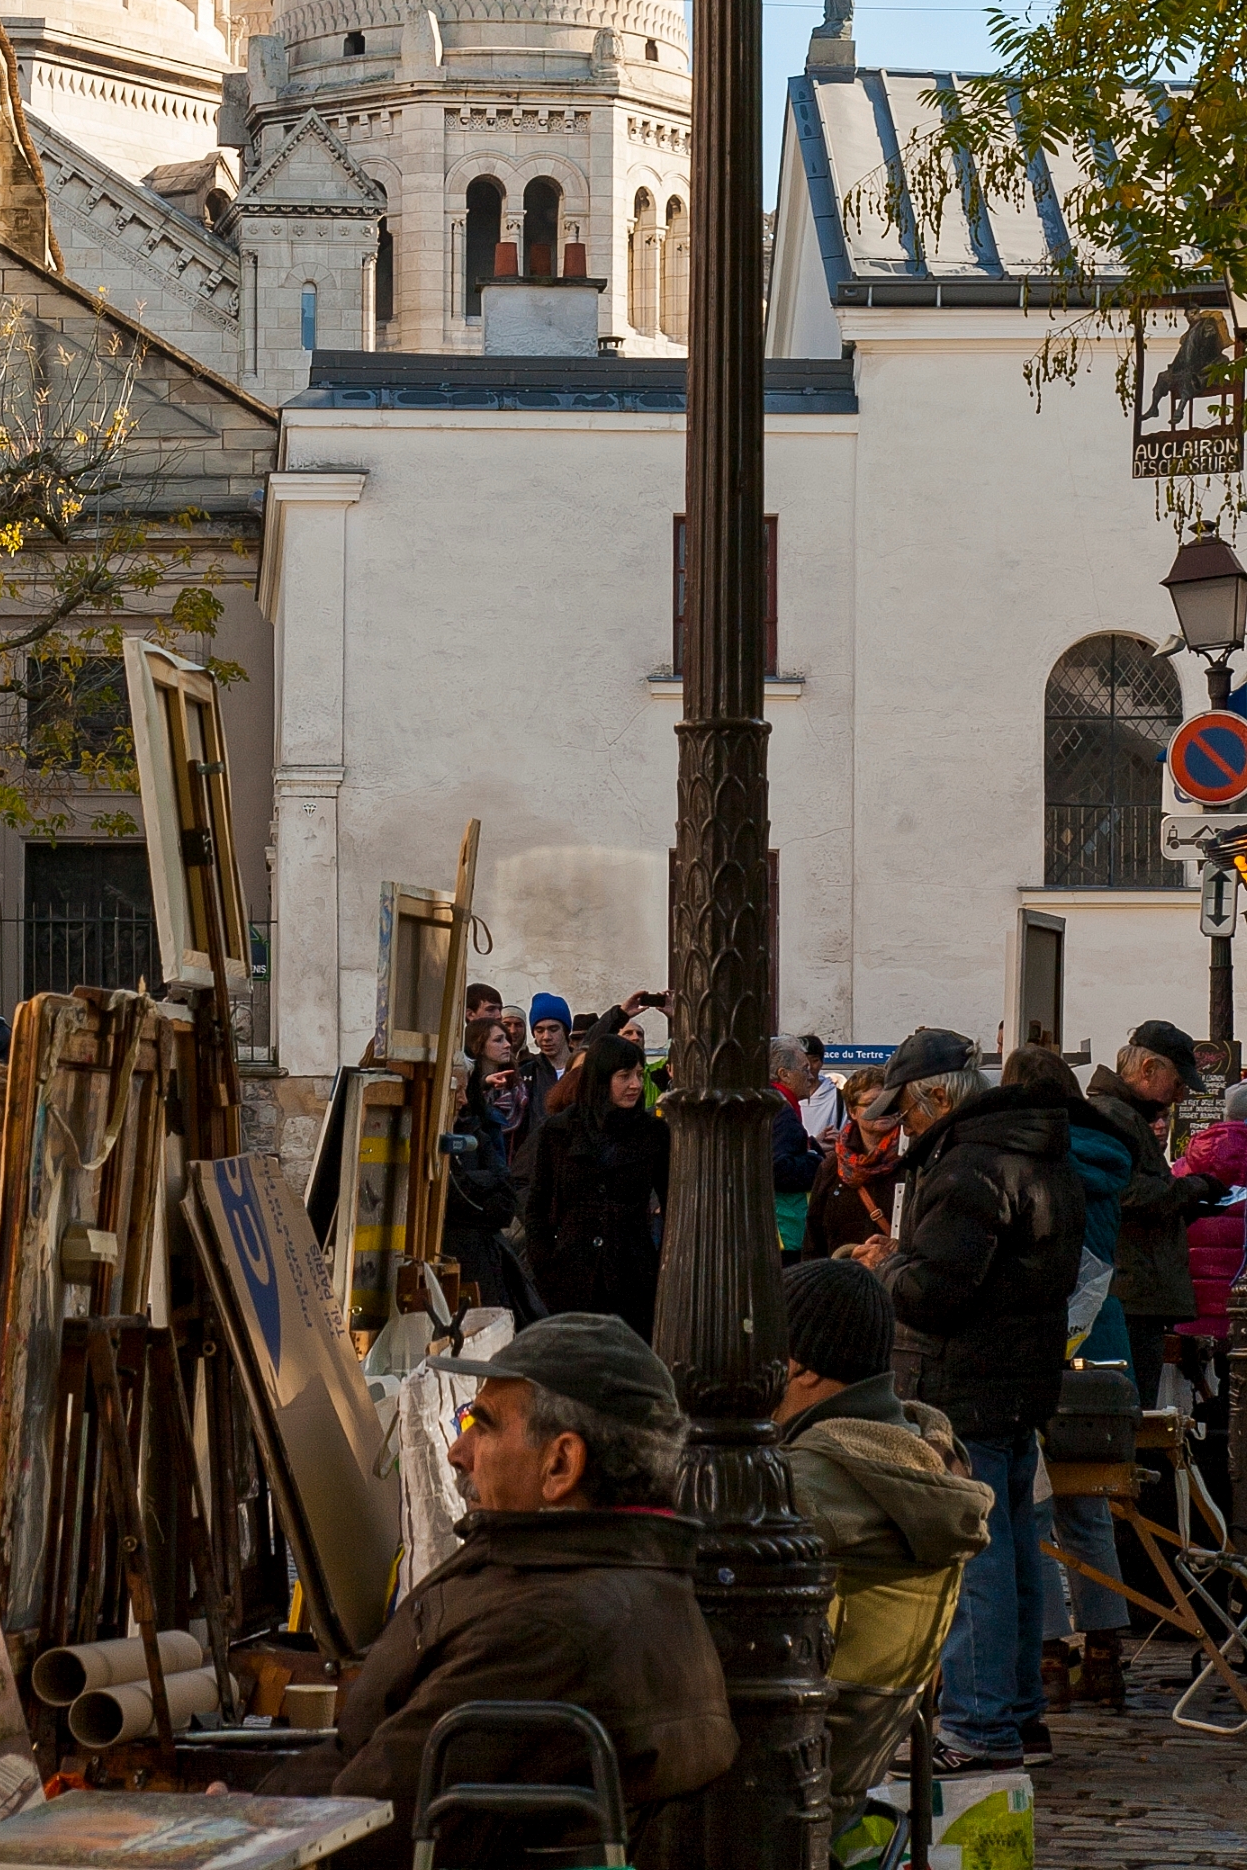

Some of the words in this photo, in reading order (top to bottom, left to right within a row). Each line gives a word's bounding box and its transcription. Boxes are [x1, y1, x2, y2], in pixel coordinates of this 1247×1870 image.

[1135, 443, 1159, 461] AU
[1161, 438, 1239, 459] CLAIRON
[1133, 460, 1157, 478] DES
[842, 1050, 854, 1059] du
[856, 1050, 884, 1059] Tertre
[309, 1243, 335, 1301] PARIS
